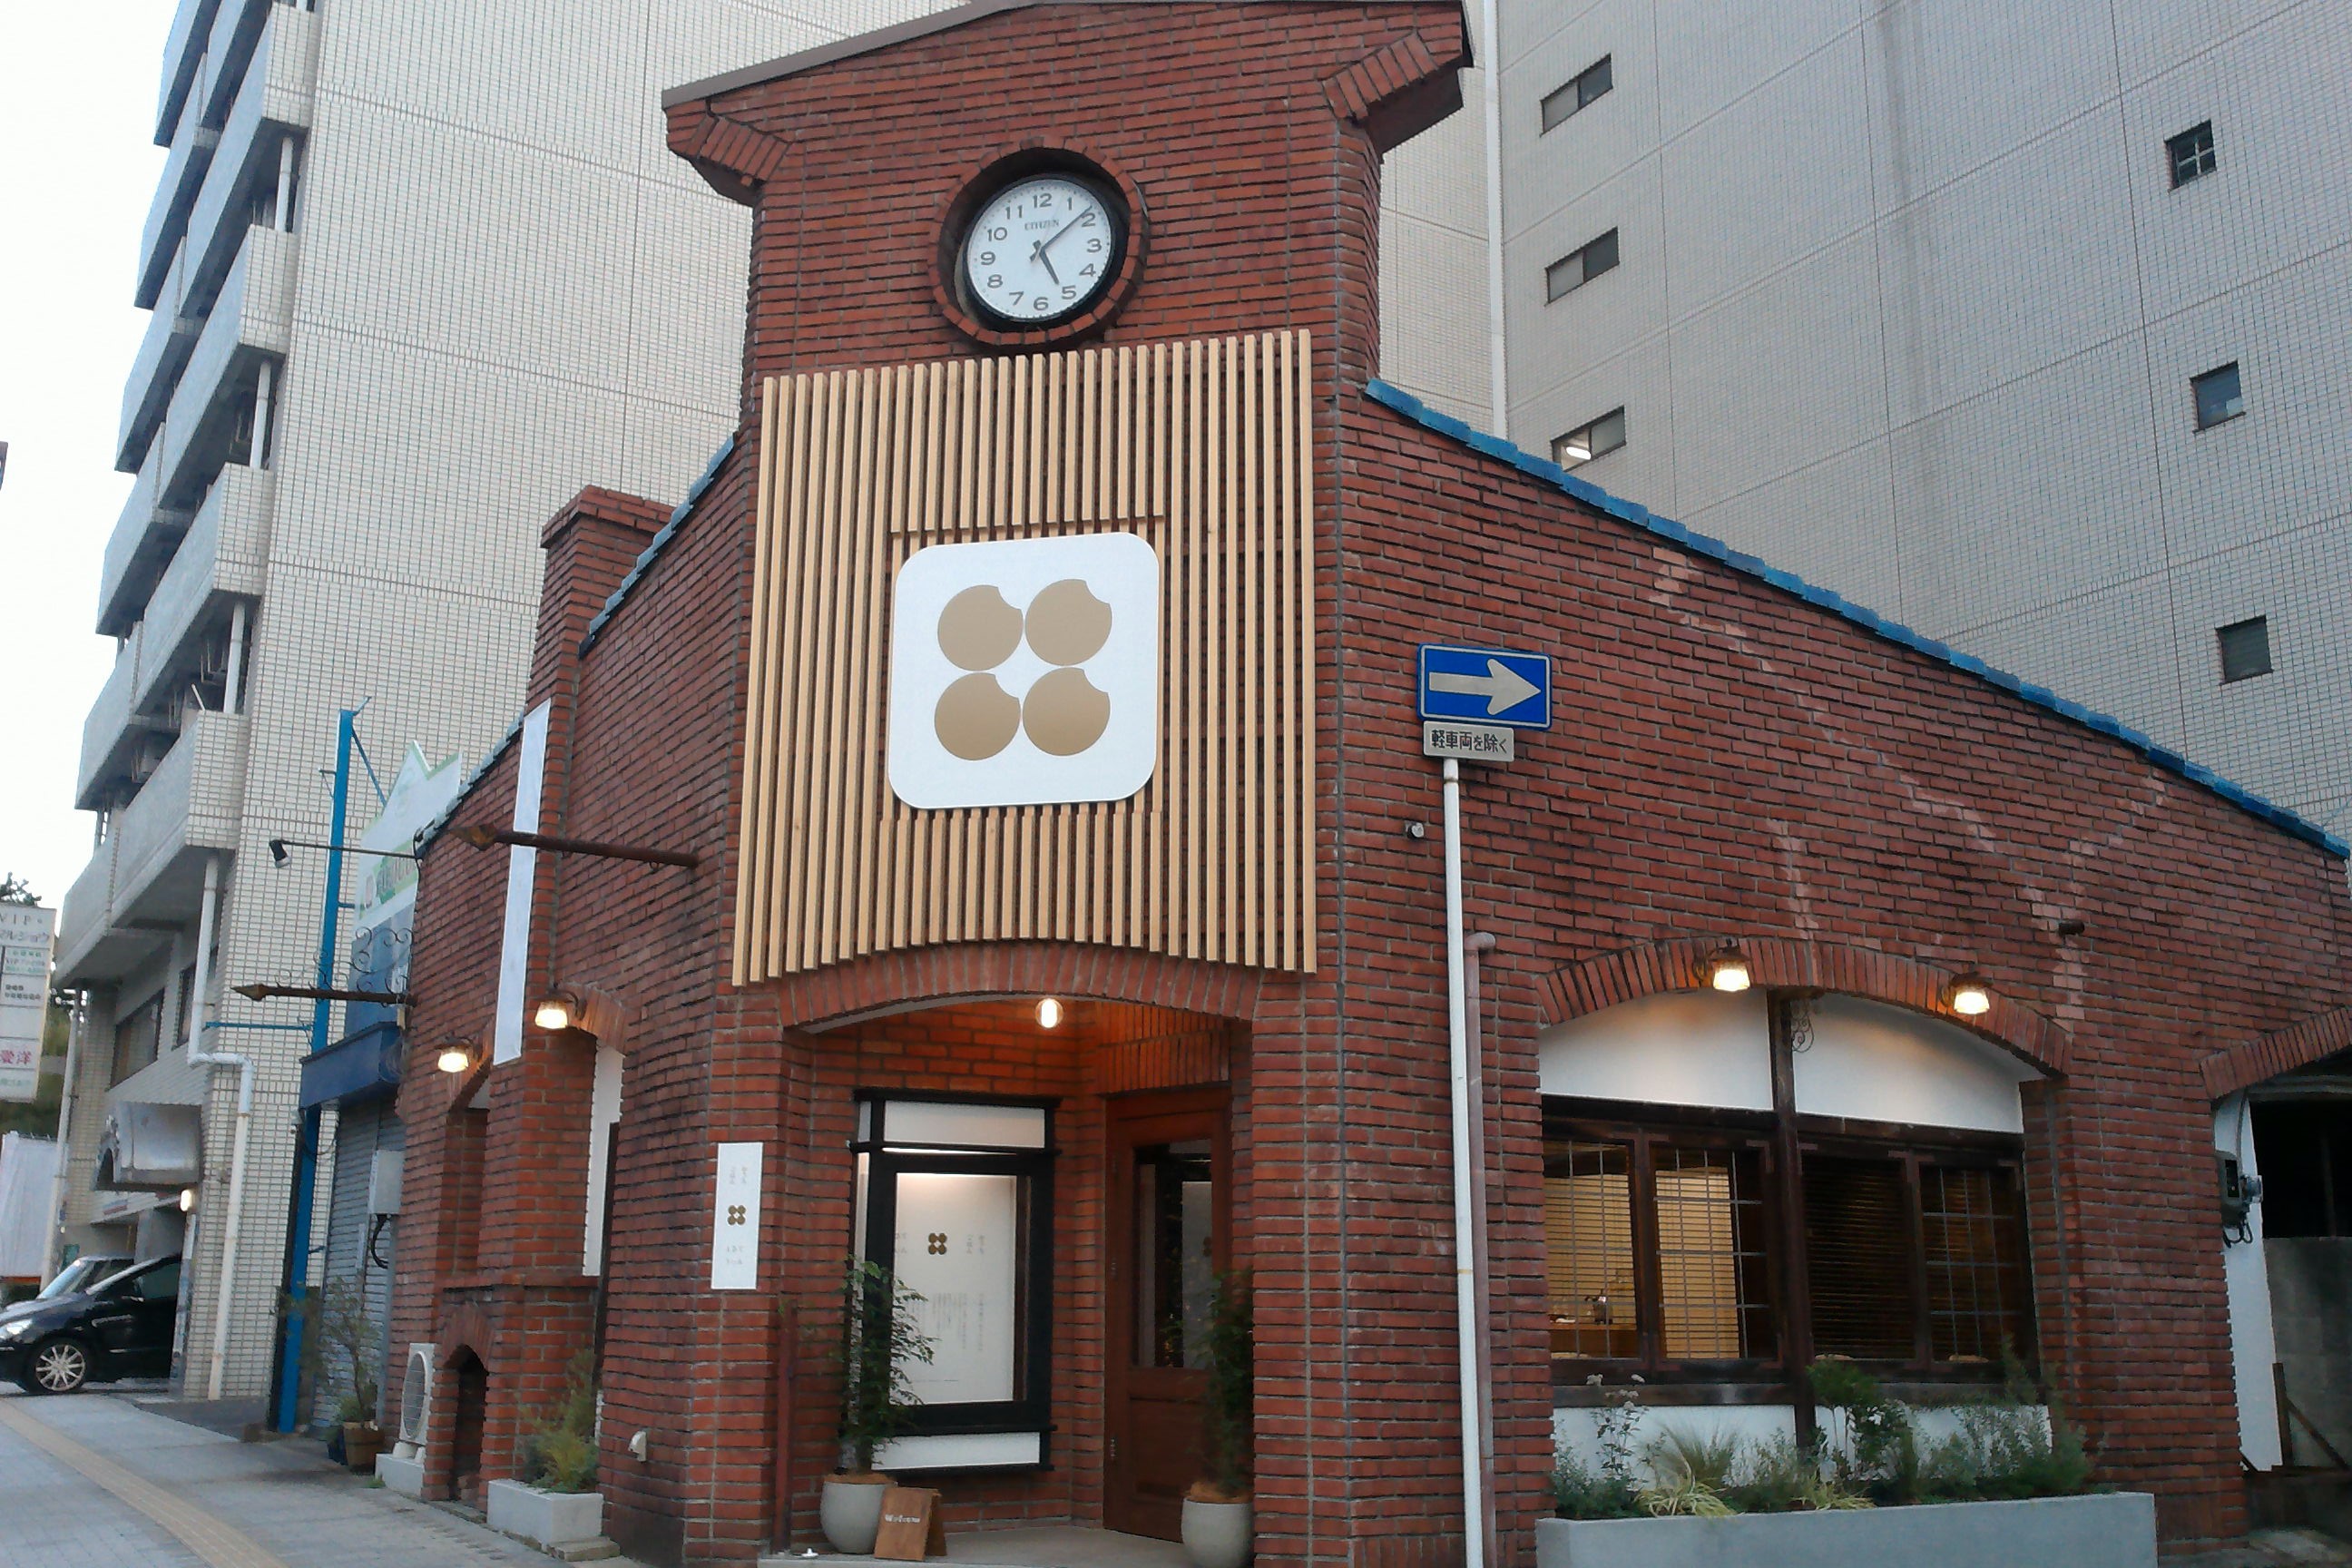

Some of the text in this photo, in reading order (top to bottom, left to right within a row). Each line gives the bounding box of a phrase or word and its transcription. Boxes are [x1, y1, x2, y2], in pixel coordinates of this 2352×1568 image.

[1033, 192, 1053, 209] 12
[1066, 197, 1073, 211] 1
[1005, 205, 1024, 220] 11
[1081, 212, 1097, 228] 2
[1024, 219, 1060, 230] CITIZEN
[987, 227, 1008, 241] 10
[1086, 238, 1102, 253] 3
[980, 250, 996, 266] 9
[1078, 263, 1097, 278] 4
[986, 274, 1004, 289] 8
[1008, 291, 1024, 306] 7
[1061, 285, 1077, 300] 5
[1033, 297, 1050, 311] 6
[1431, 729, 1507, 754] 軽車両を除く
